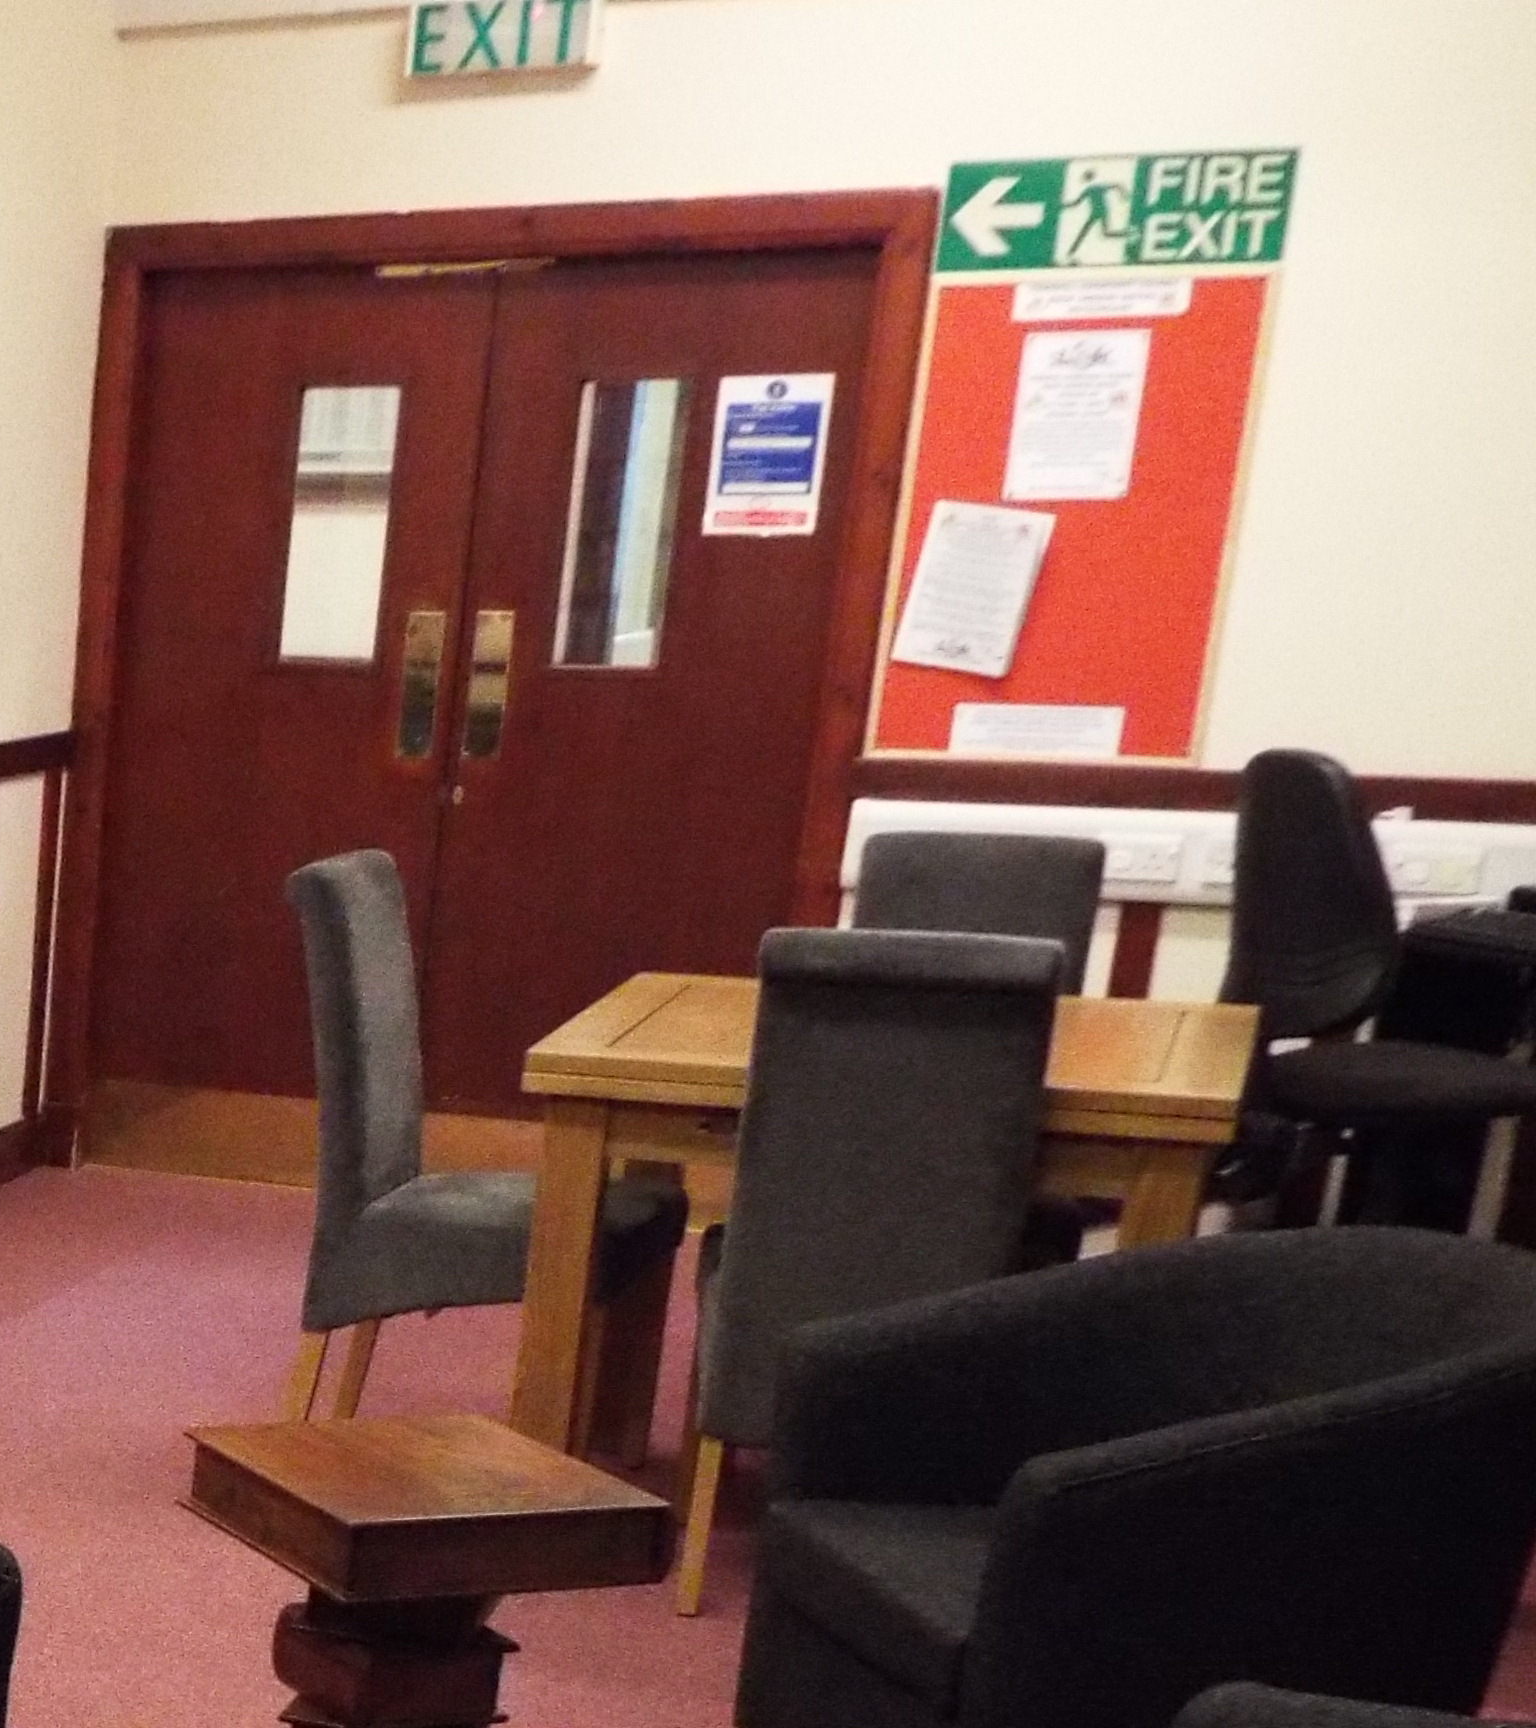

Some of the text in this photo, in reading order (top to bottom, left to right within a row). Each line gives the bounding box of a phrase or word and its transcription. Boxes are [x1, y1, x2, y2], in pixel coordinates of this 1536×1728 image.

[412, 0, 578, 73] EXIT
[1145, 153, 1290, 207] FIRE
[1140, 209, 1282, 262] EXIT
